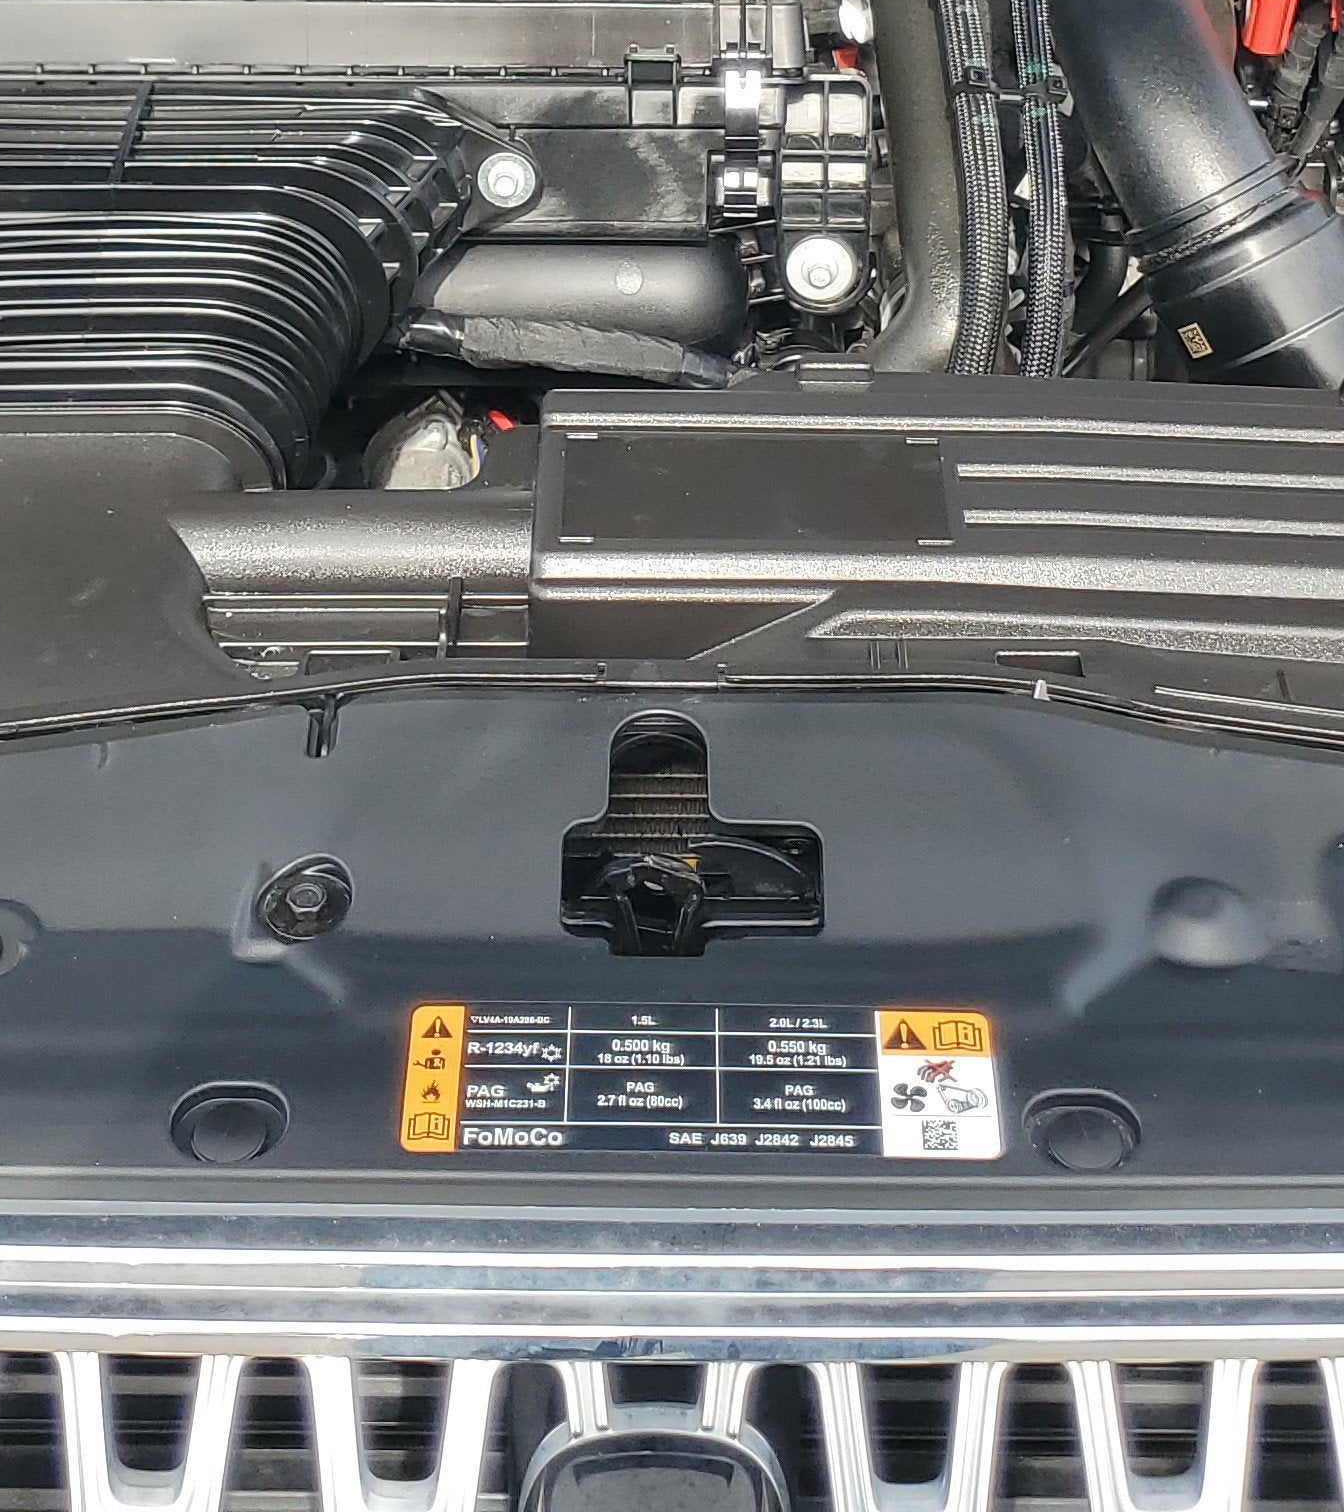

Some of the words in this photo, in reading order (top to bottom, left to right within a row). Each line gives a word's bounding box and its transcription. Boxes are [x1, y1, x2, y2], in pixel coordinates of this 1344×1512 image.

[631, 1015, 656, 1026] 1.5L
[467, 1041, 540, 1057] R-1234yf
[611, 1038, 649, 1052] 0.500
[652, 1039, 671, 1054] kg
[767, 1040, 805, 1053] 0.550
[808, 1040, 827, 1055] kg
[597, 1053, 612, 1064] 18
[613, 1055, 630, 1064] oz
[631, 1053, 660, 1066] (1.10
[662, 1054, 685, 1066] lbs)
[748, 1054, 774, 1065] 19.5
[776, 1056, 792, 1066] oz
[793, 1055, 821, 1067] (1.21
[824, 1055, 847, 1068] lbs)
[466, 1084, 506, 1098] PAG
[626, 1081, 655, 1093] PAG
[784, 1084, 814, 1096] PAG
[597, 1094, 616, 1106] 2.7
[617, 1094, 627, 1106] fl
[628, 1097, 644, 1106] oz
[753, 1097, 772, 1109] 3.4
[774, 1097, 782, 1109] fl
[784, 1100, 800, 1110] oz
[802, 1098, 846, 1113] (100cc)
[463, 1127, 563, 1146] FoMoCo
[669, 1132, 703, 1145] SAE
[710, 1132, 747, 1146] J639
[754, 1133, 799, 1146] J2842
[809, 1134, 855, 1148] J2845
